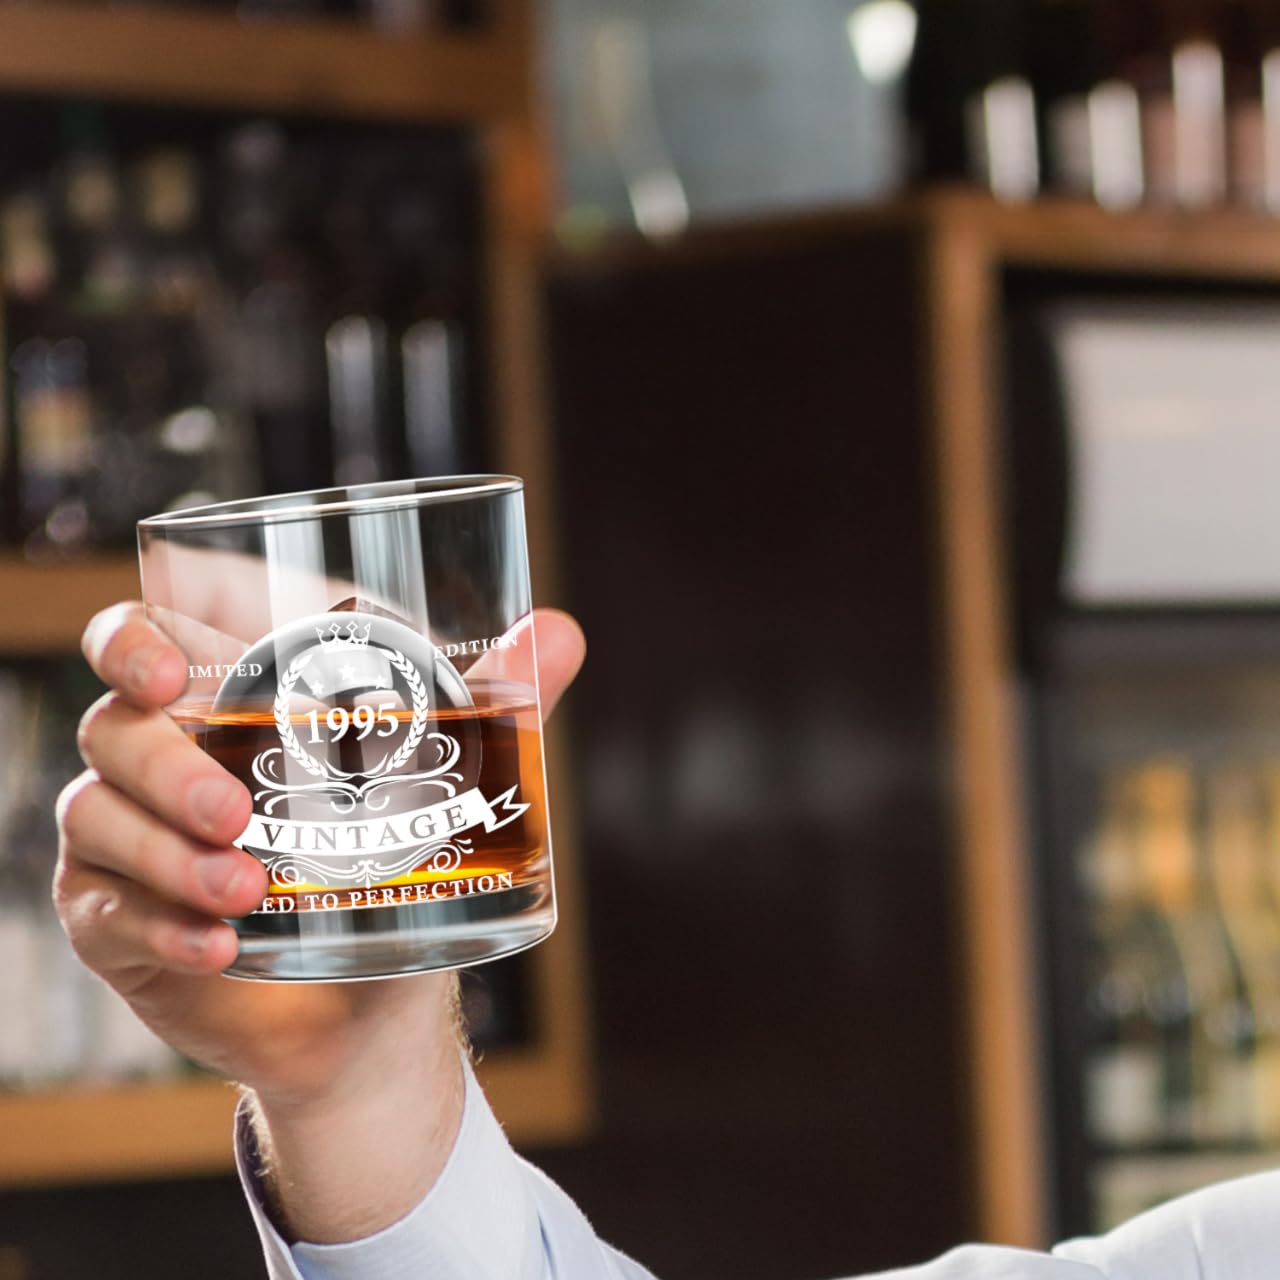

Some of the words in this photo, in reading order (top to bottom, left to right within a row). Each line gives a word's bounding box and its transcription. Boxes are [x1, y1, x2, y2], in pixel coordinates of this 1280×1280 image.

[188, 663, 263, 678] IMITED
[434, 631, 518, 659] EDITION
[304, 702, 399, 744] 1995
[260, 804, 468, 850] VINTAGE
[251, 896, 295, 914] ED
[305, 893, 339, 912] TO
[348, 871, 513, 908] PERFECTION
